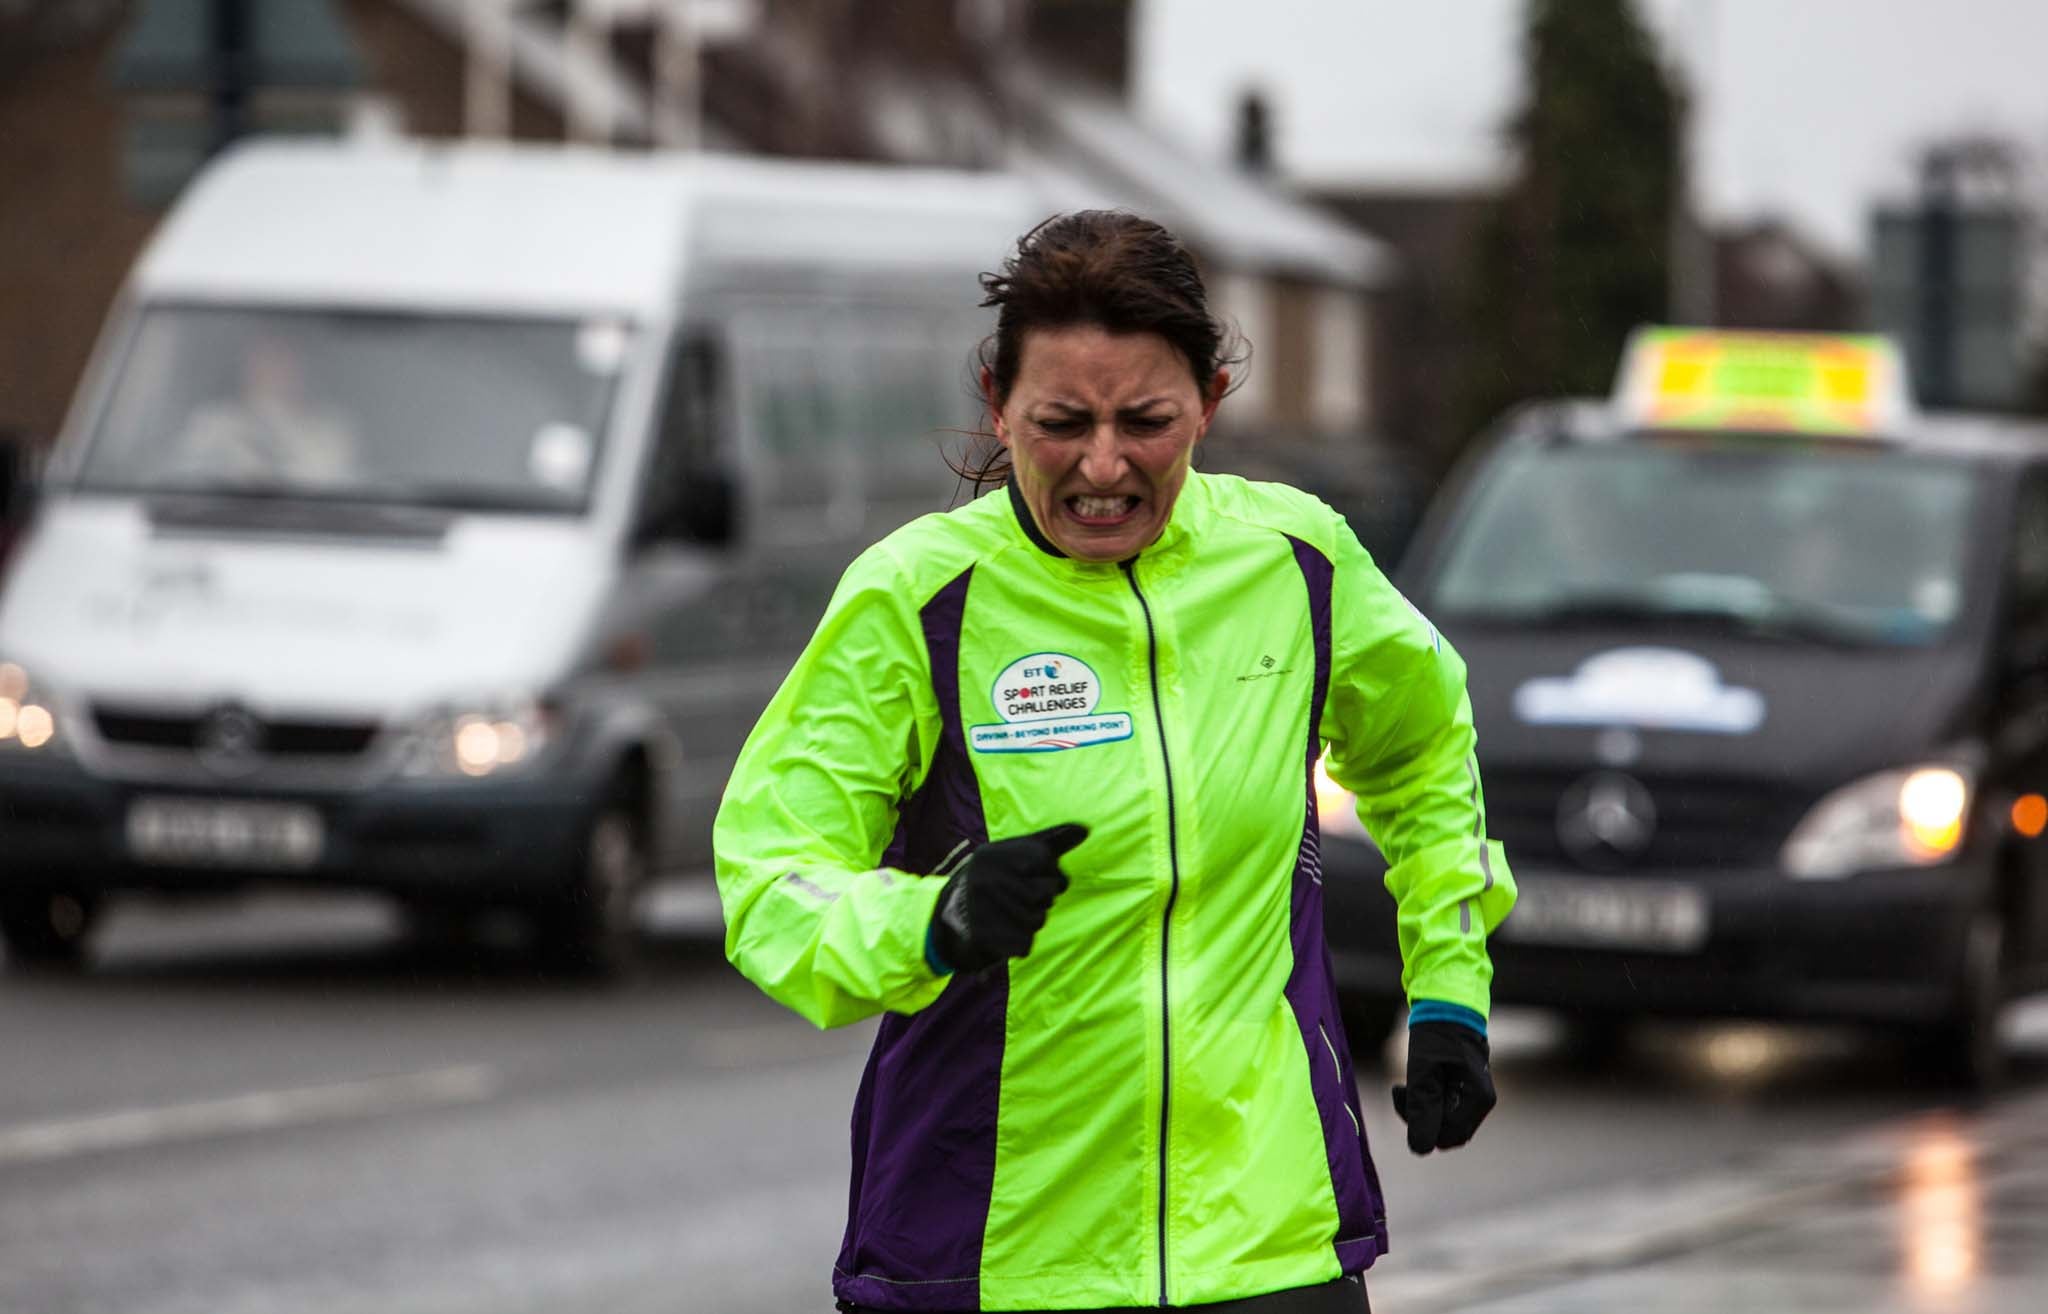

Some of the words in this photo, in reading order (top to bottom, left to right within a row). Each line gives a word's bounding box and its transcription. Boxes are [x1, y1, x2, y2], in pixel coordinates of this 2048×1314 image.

[1023, 668, 1042, 678] BT
[1004, 685, 1045, 701] SPORT
[1049, 681, 1088, 696] RELIEF
[1008, 697, 1087, 715] CHALLENGES
[1015, 727, 1050, 739] BEYOND
[1053, 723, 1097, 735] BREAKING
[1100, 720, 1124, 730] POINT
